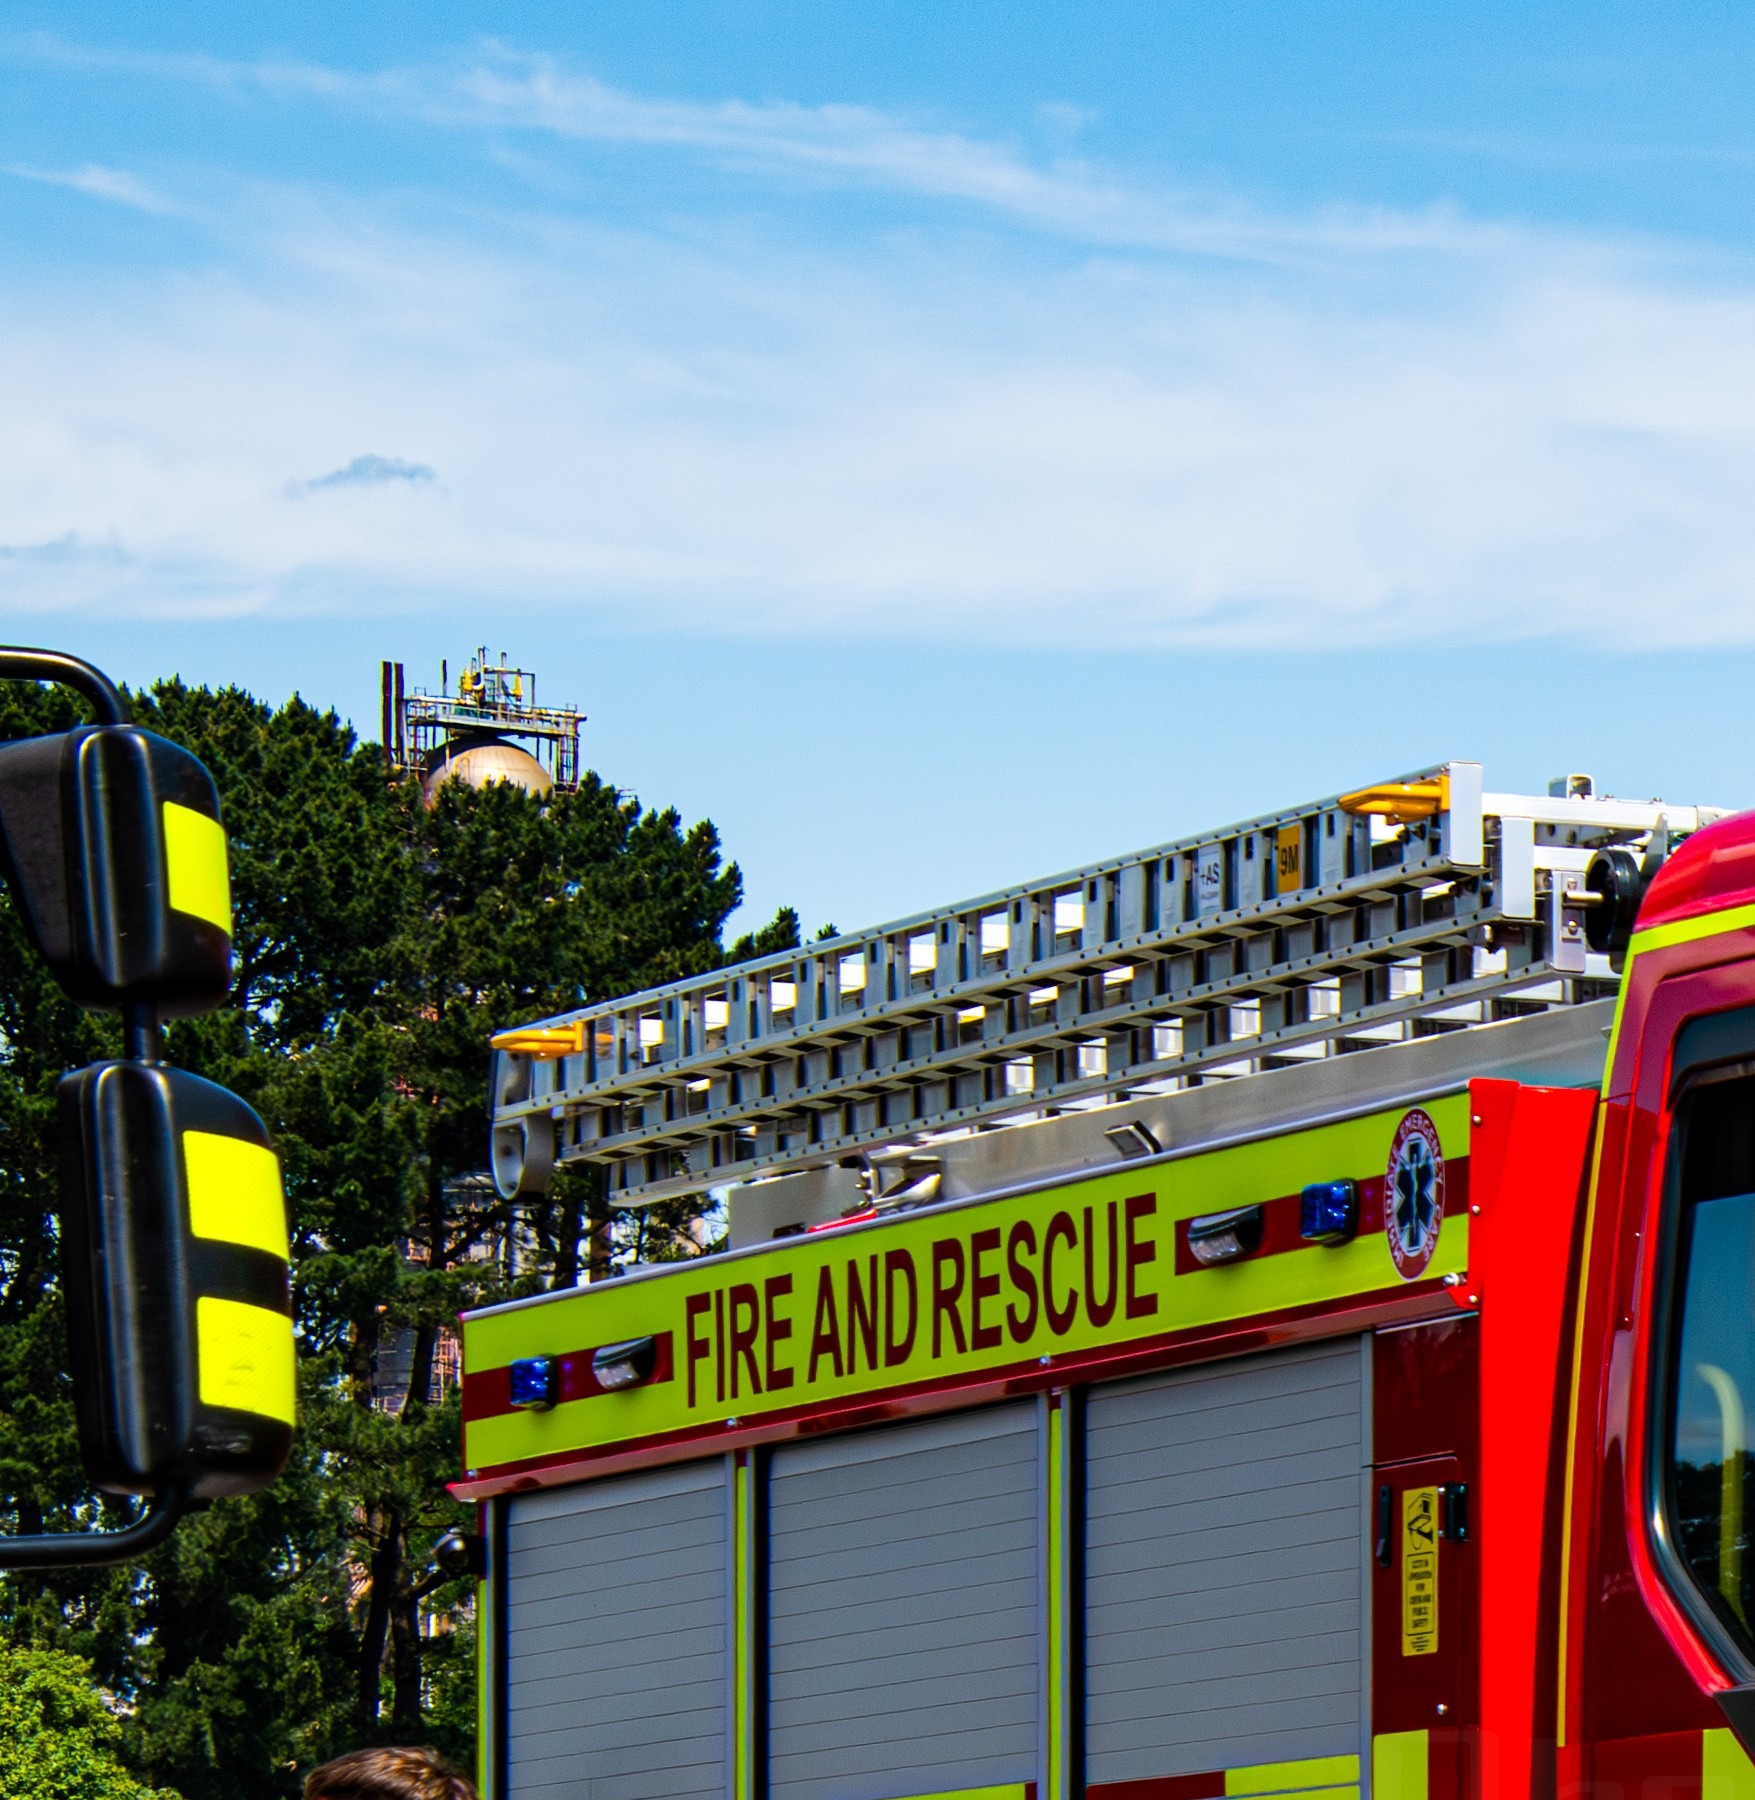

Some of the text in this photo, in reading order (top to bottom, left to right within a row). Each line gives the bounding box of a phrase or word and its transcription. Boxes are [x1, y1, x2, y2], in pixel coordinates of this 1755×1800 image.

[1281, 844, 1299, 876] 9M
[685, 1192, 1158, 1408] FIRE AND RESCUE
